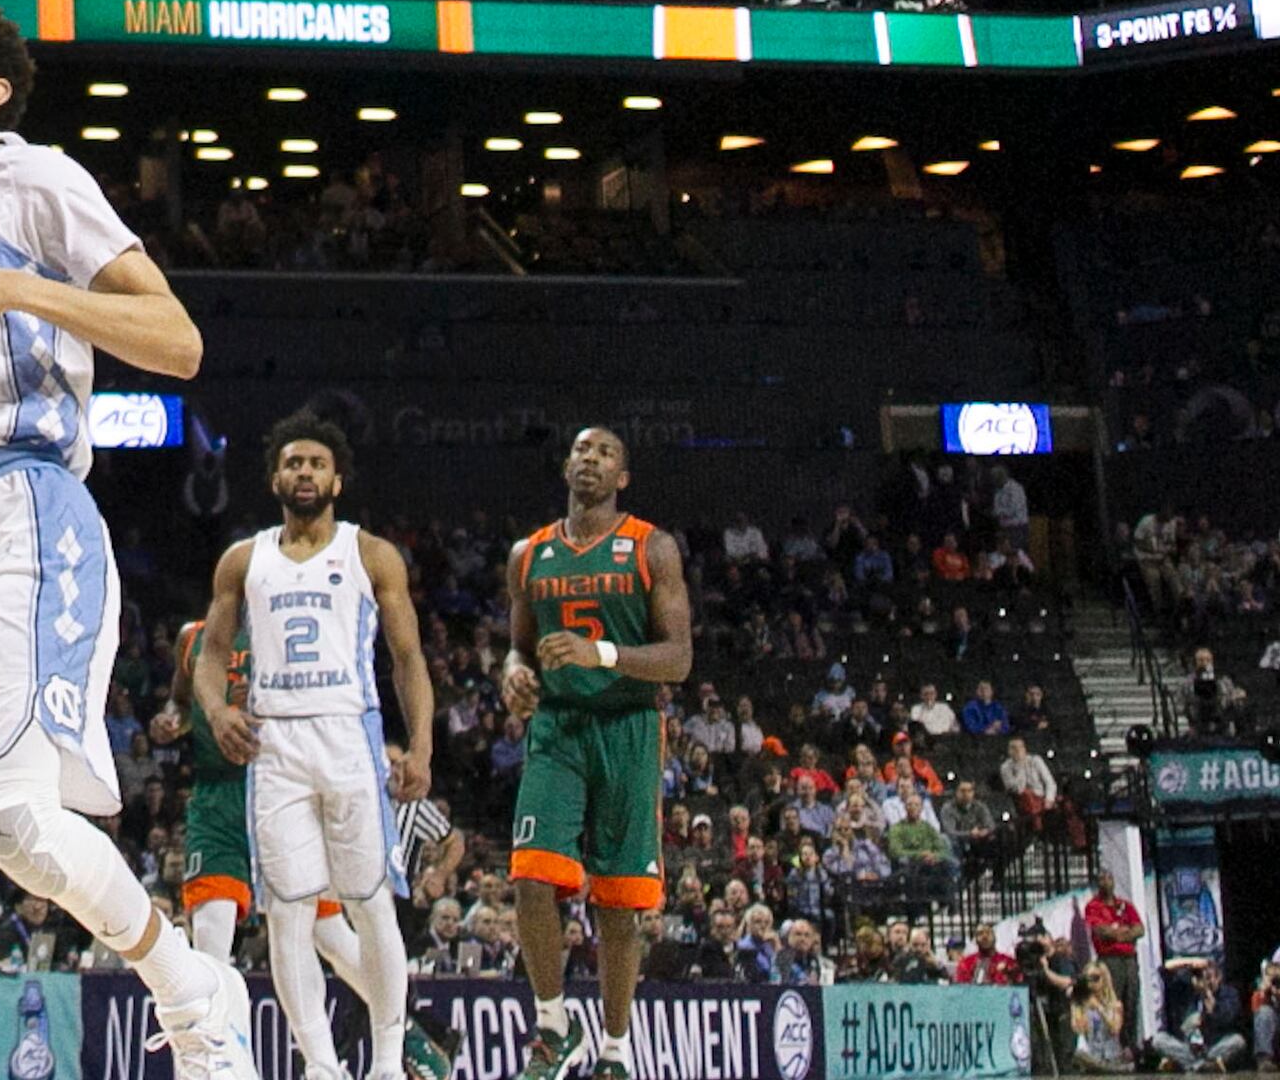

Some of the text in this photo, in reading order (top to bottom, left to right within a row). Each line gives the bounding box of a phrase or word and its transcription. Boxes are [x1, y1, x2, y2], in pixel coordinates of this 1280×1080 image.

[208, 0, 390, 43] HURRICANES
[1096, 13, 1180, 48] 3-POINT
[269, 591, 333, 613] NORTH
[561, 600, 605, 642] 5
[285, 616, 320, 663] 2
[258, 671, 352, 691] CAROLINA
